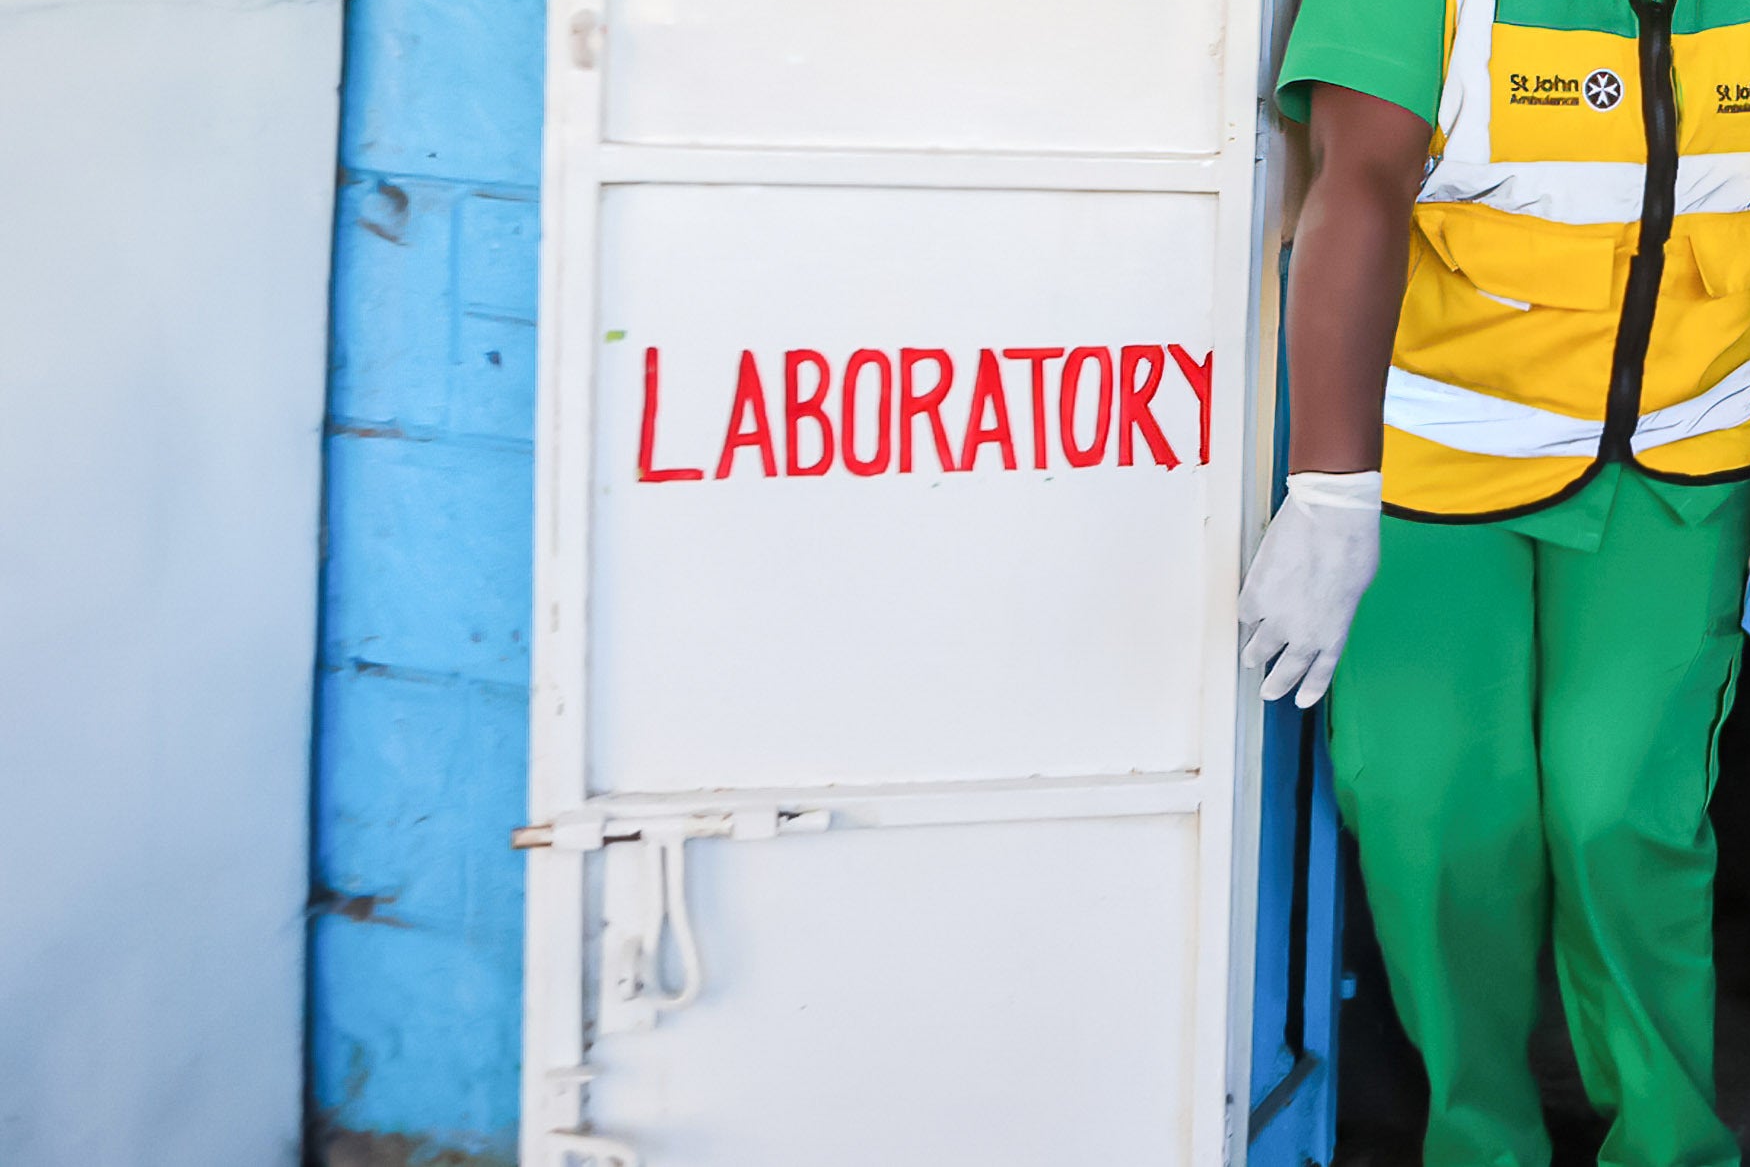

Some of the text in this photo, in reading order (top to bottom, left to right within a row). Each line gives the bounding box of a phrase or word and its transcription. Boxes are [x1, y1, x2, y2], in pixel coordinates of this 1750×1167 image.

[1510, 74, 1579, 92] St John
[1716, 84, 1732, 101] St
[637, 344, 1213, 482] LABORATORY
